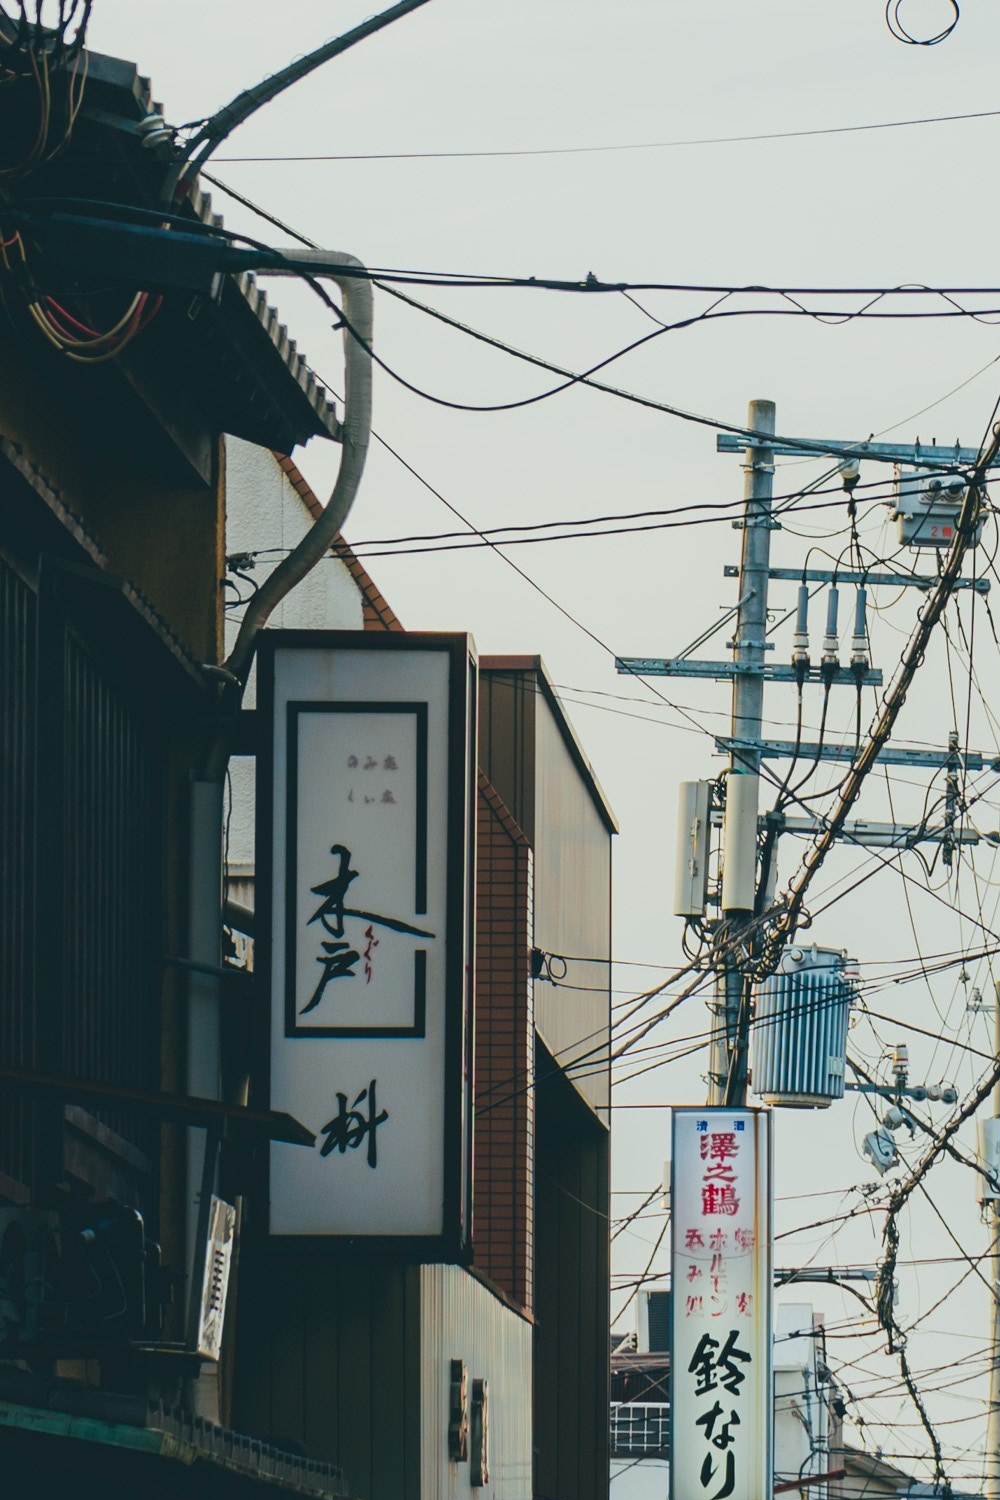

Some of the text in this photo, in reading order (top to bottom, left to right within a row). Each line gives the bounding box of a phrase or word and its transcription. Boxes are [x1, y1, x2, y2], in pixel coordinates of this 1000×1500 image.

[299, 844, 436, 1015] 木戸
[699, 1131, 741, 1217] 澤之鶴
